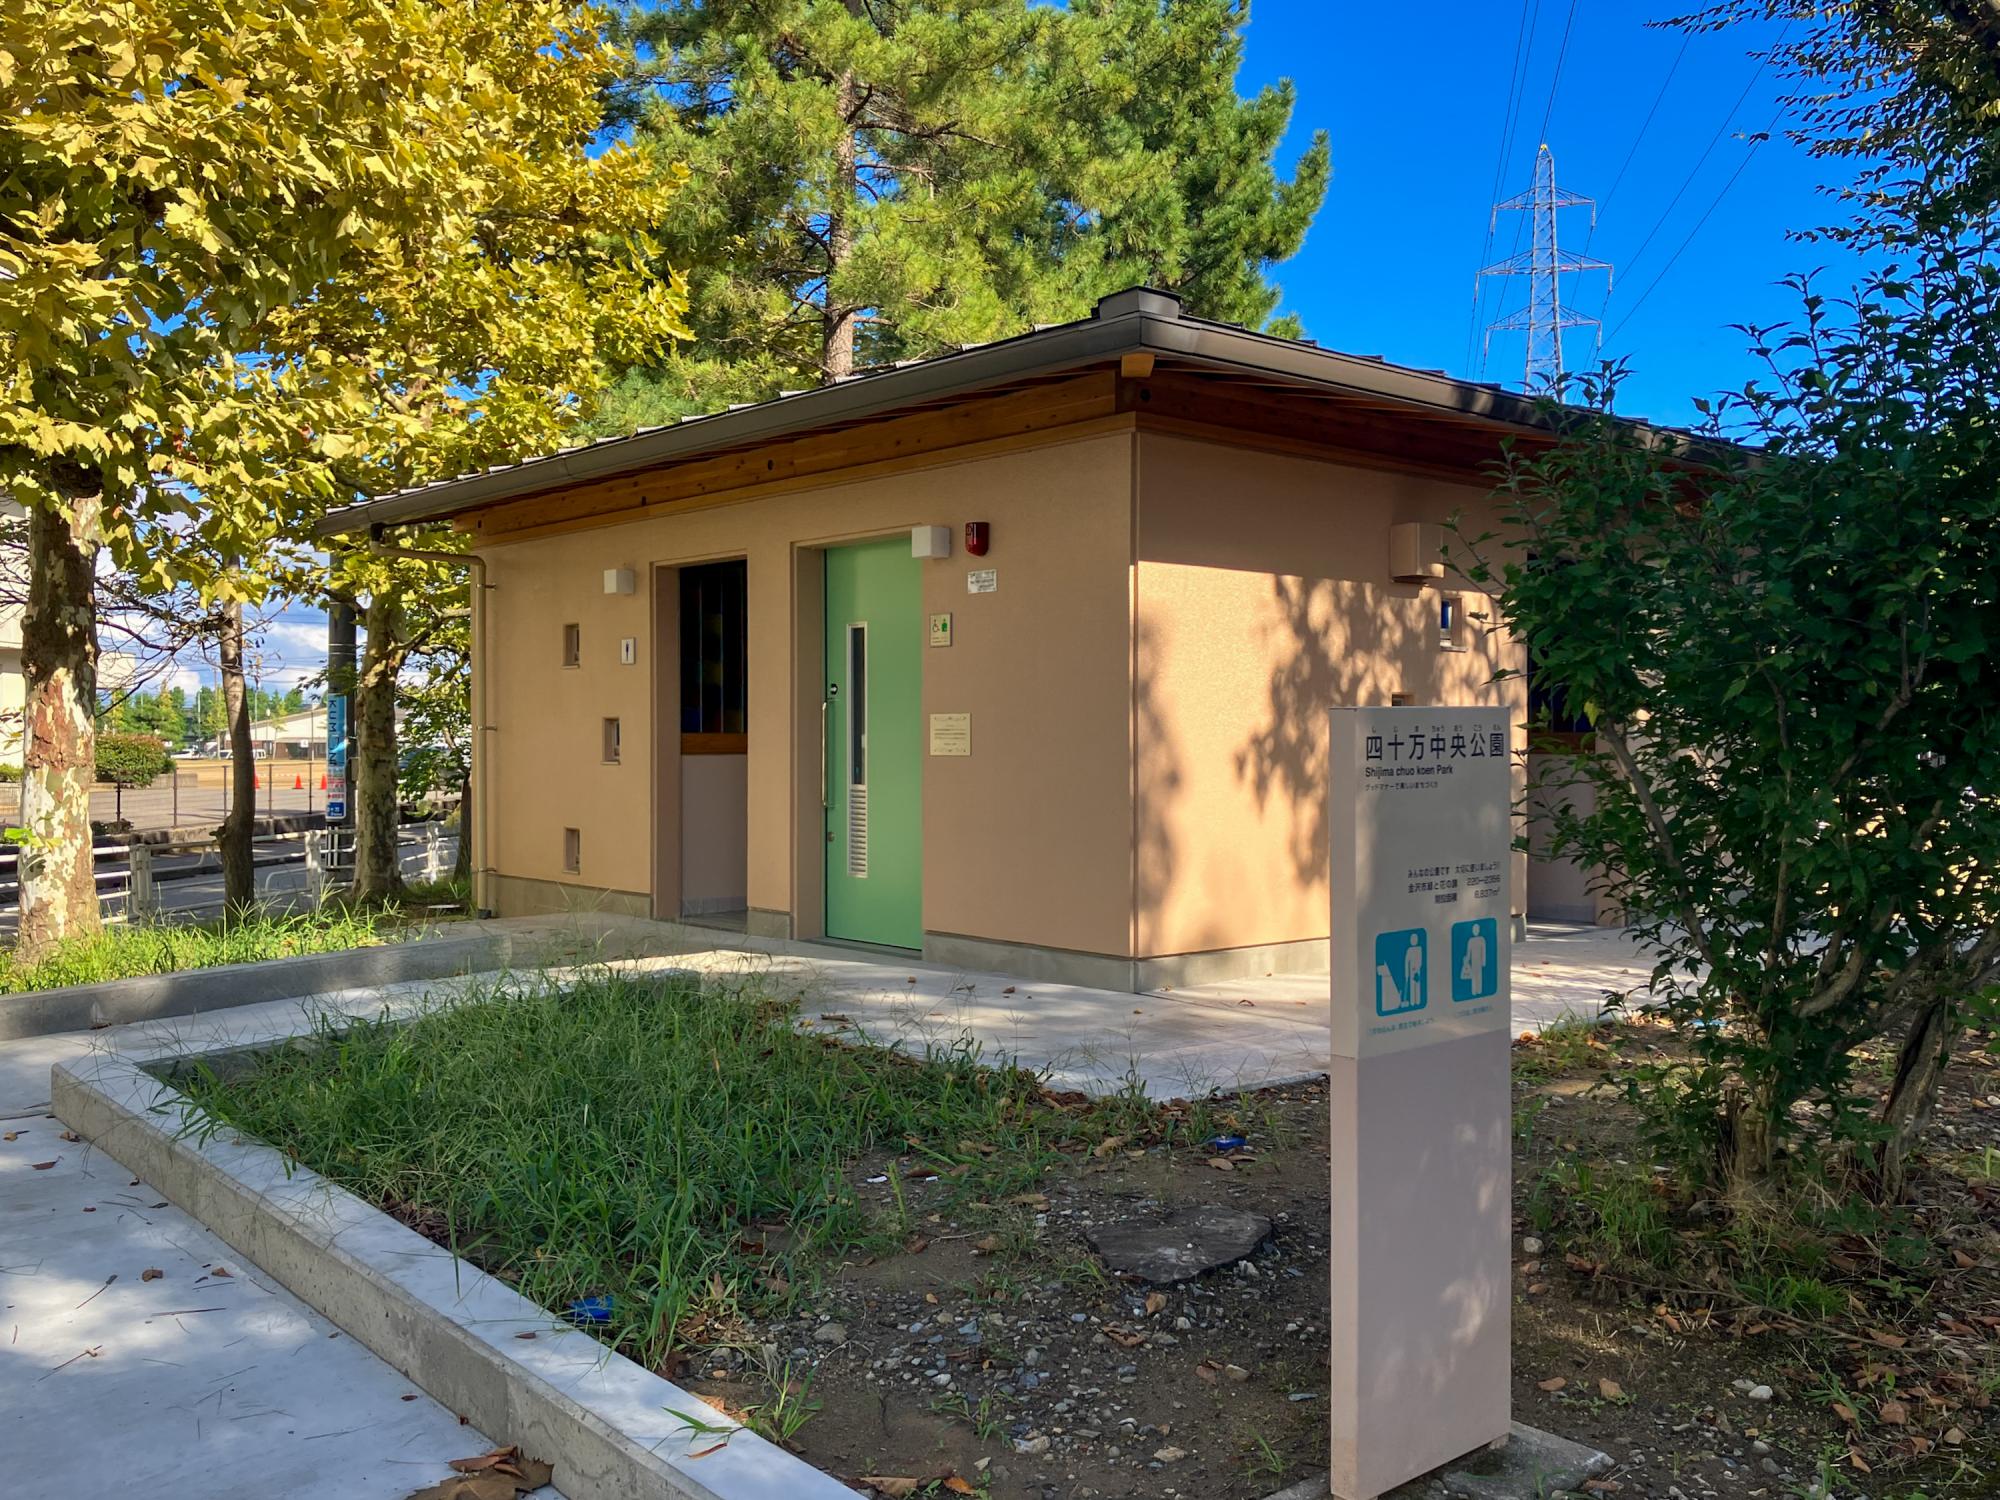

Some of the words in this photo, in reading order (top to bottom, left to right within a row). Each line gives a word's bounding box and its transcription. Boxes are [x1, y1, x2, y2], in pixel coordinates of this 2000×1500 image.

[1366, 733, 1504, 761] 四十万中央公園
[1365, 767, 1394, 779] Shijima
[1395, 766, 1415, 776] chuo
[1416, 765, 1435, 775] koen
[1436, 764, 1454, 775] Park
